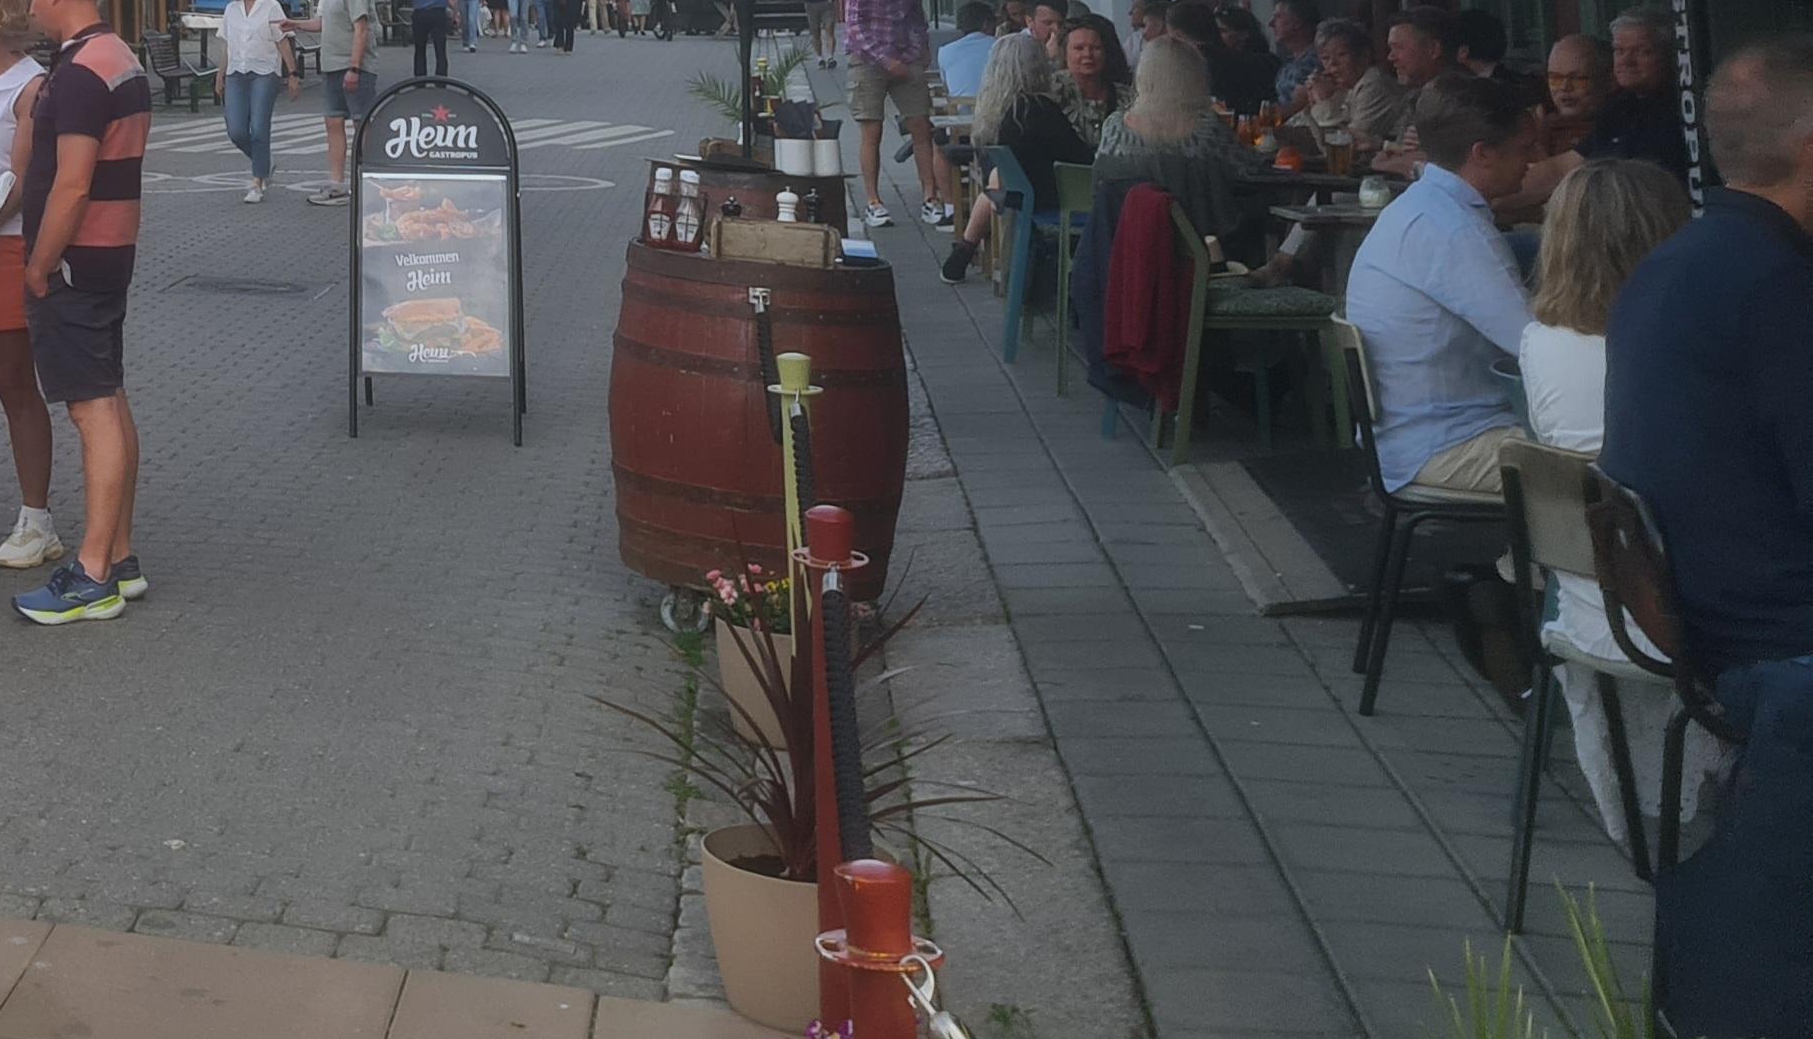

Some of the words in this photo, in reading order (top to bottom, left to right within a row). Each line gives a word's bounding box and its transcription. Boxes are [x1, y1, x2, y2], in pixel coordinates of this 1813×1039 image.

[385, 117, 478, 158] Heim
[429, 151, 478, 159] GASTROPUB
[395, 252, 460, 267] Velkommen
[406, 268, 452, 292] Heim
